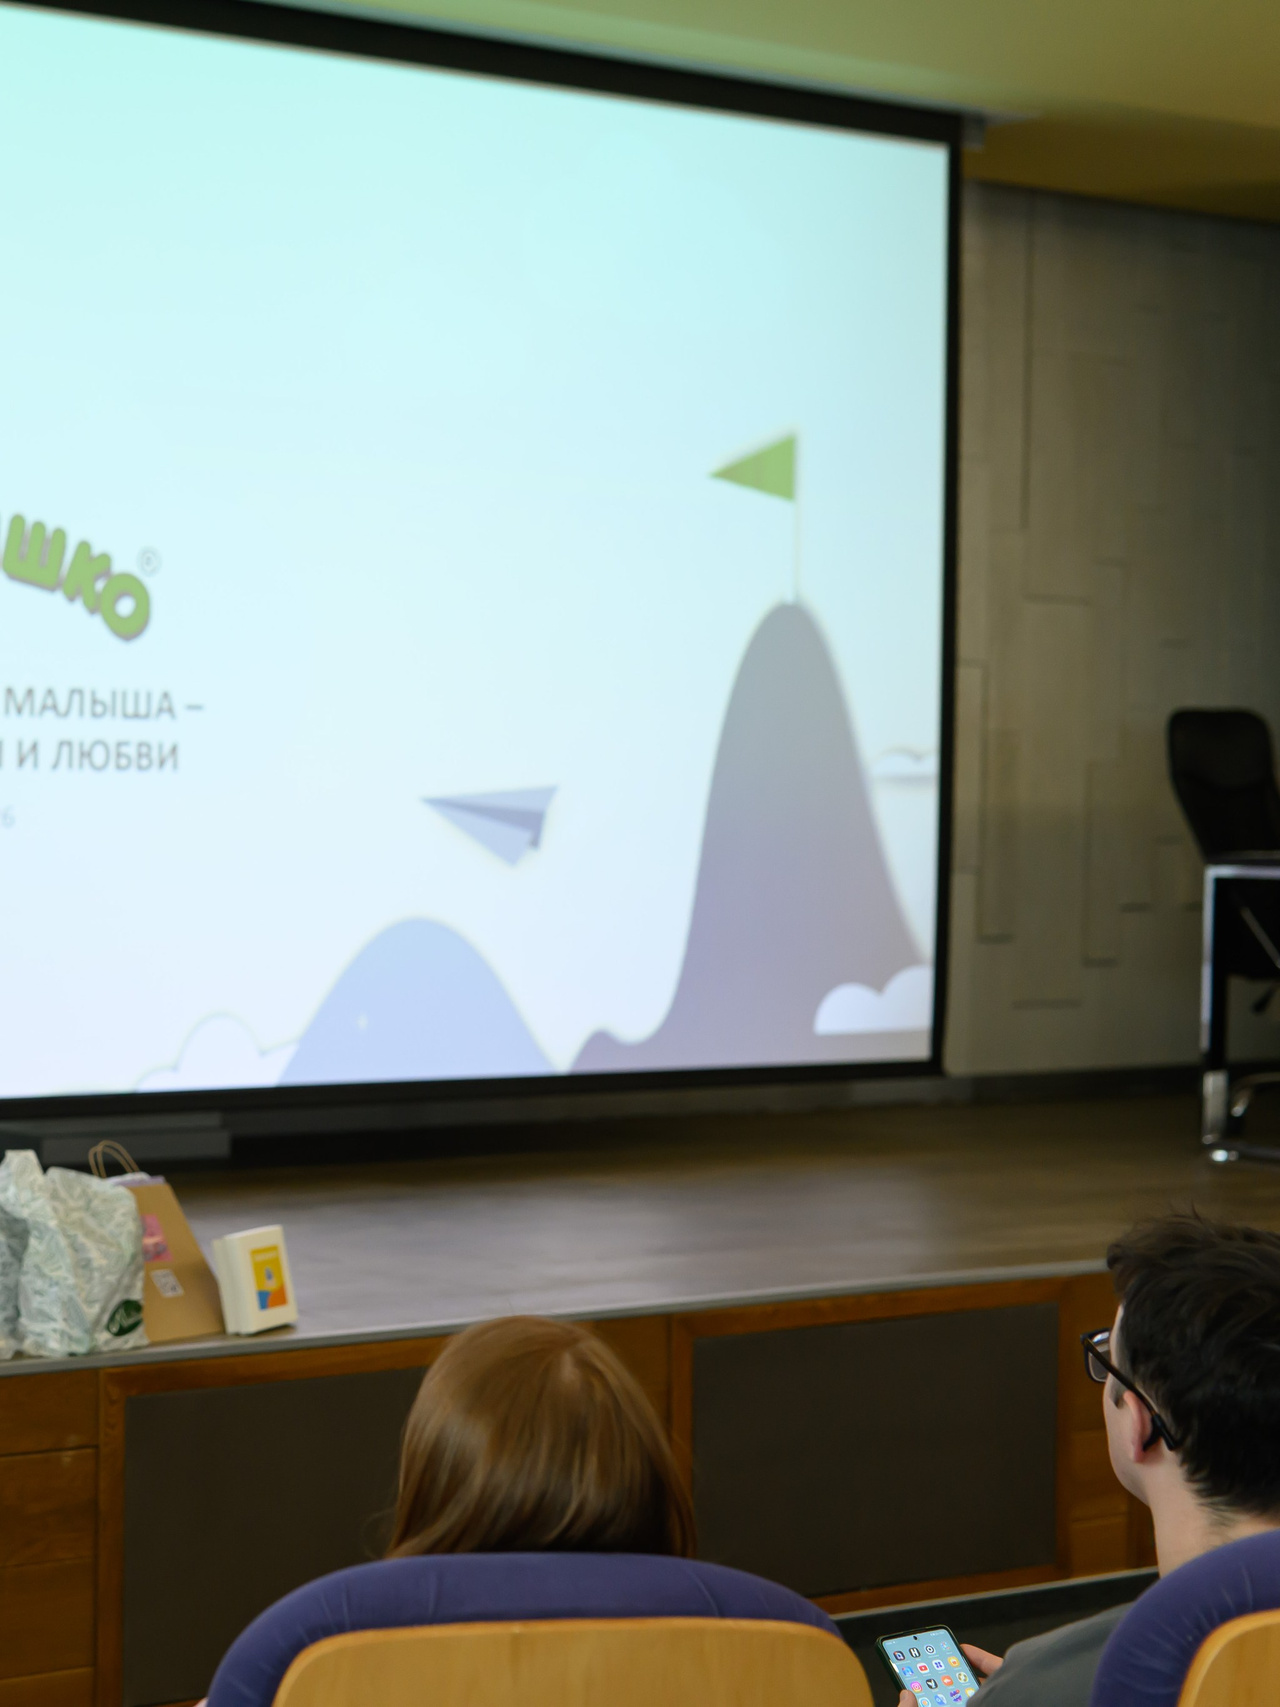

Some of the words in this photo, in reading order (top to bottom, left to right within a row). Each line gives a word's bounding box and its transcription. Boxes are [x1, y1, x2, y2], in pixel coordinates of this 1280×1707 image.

[4, 685, 177, 722] МАЛЫША
[16, 739, 40, 770] И
[51, 738, 180, 772] ЛЮБВИ
